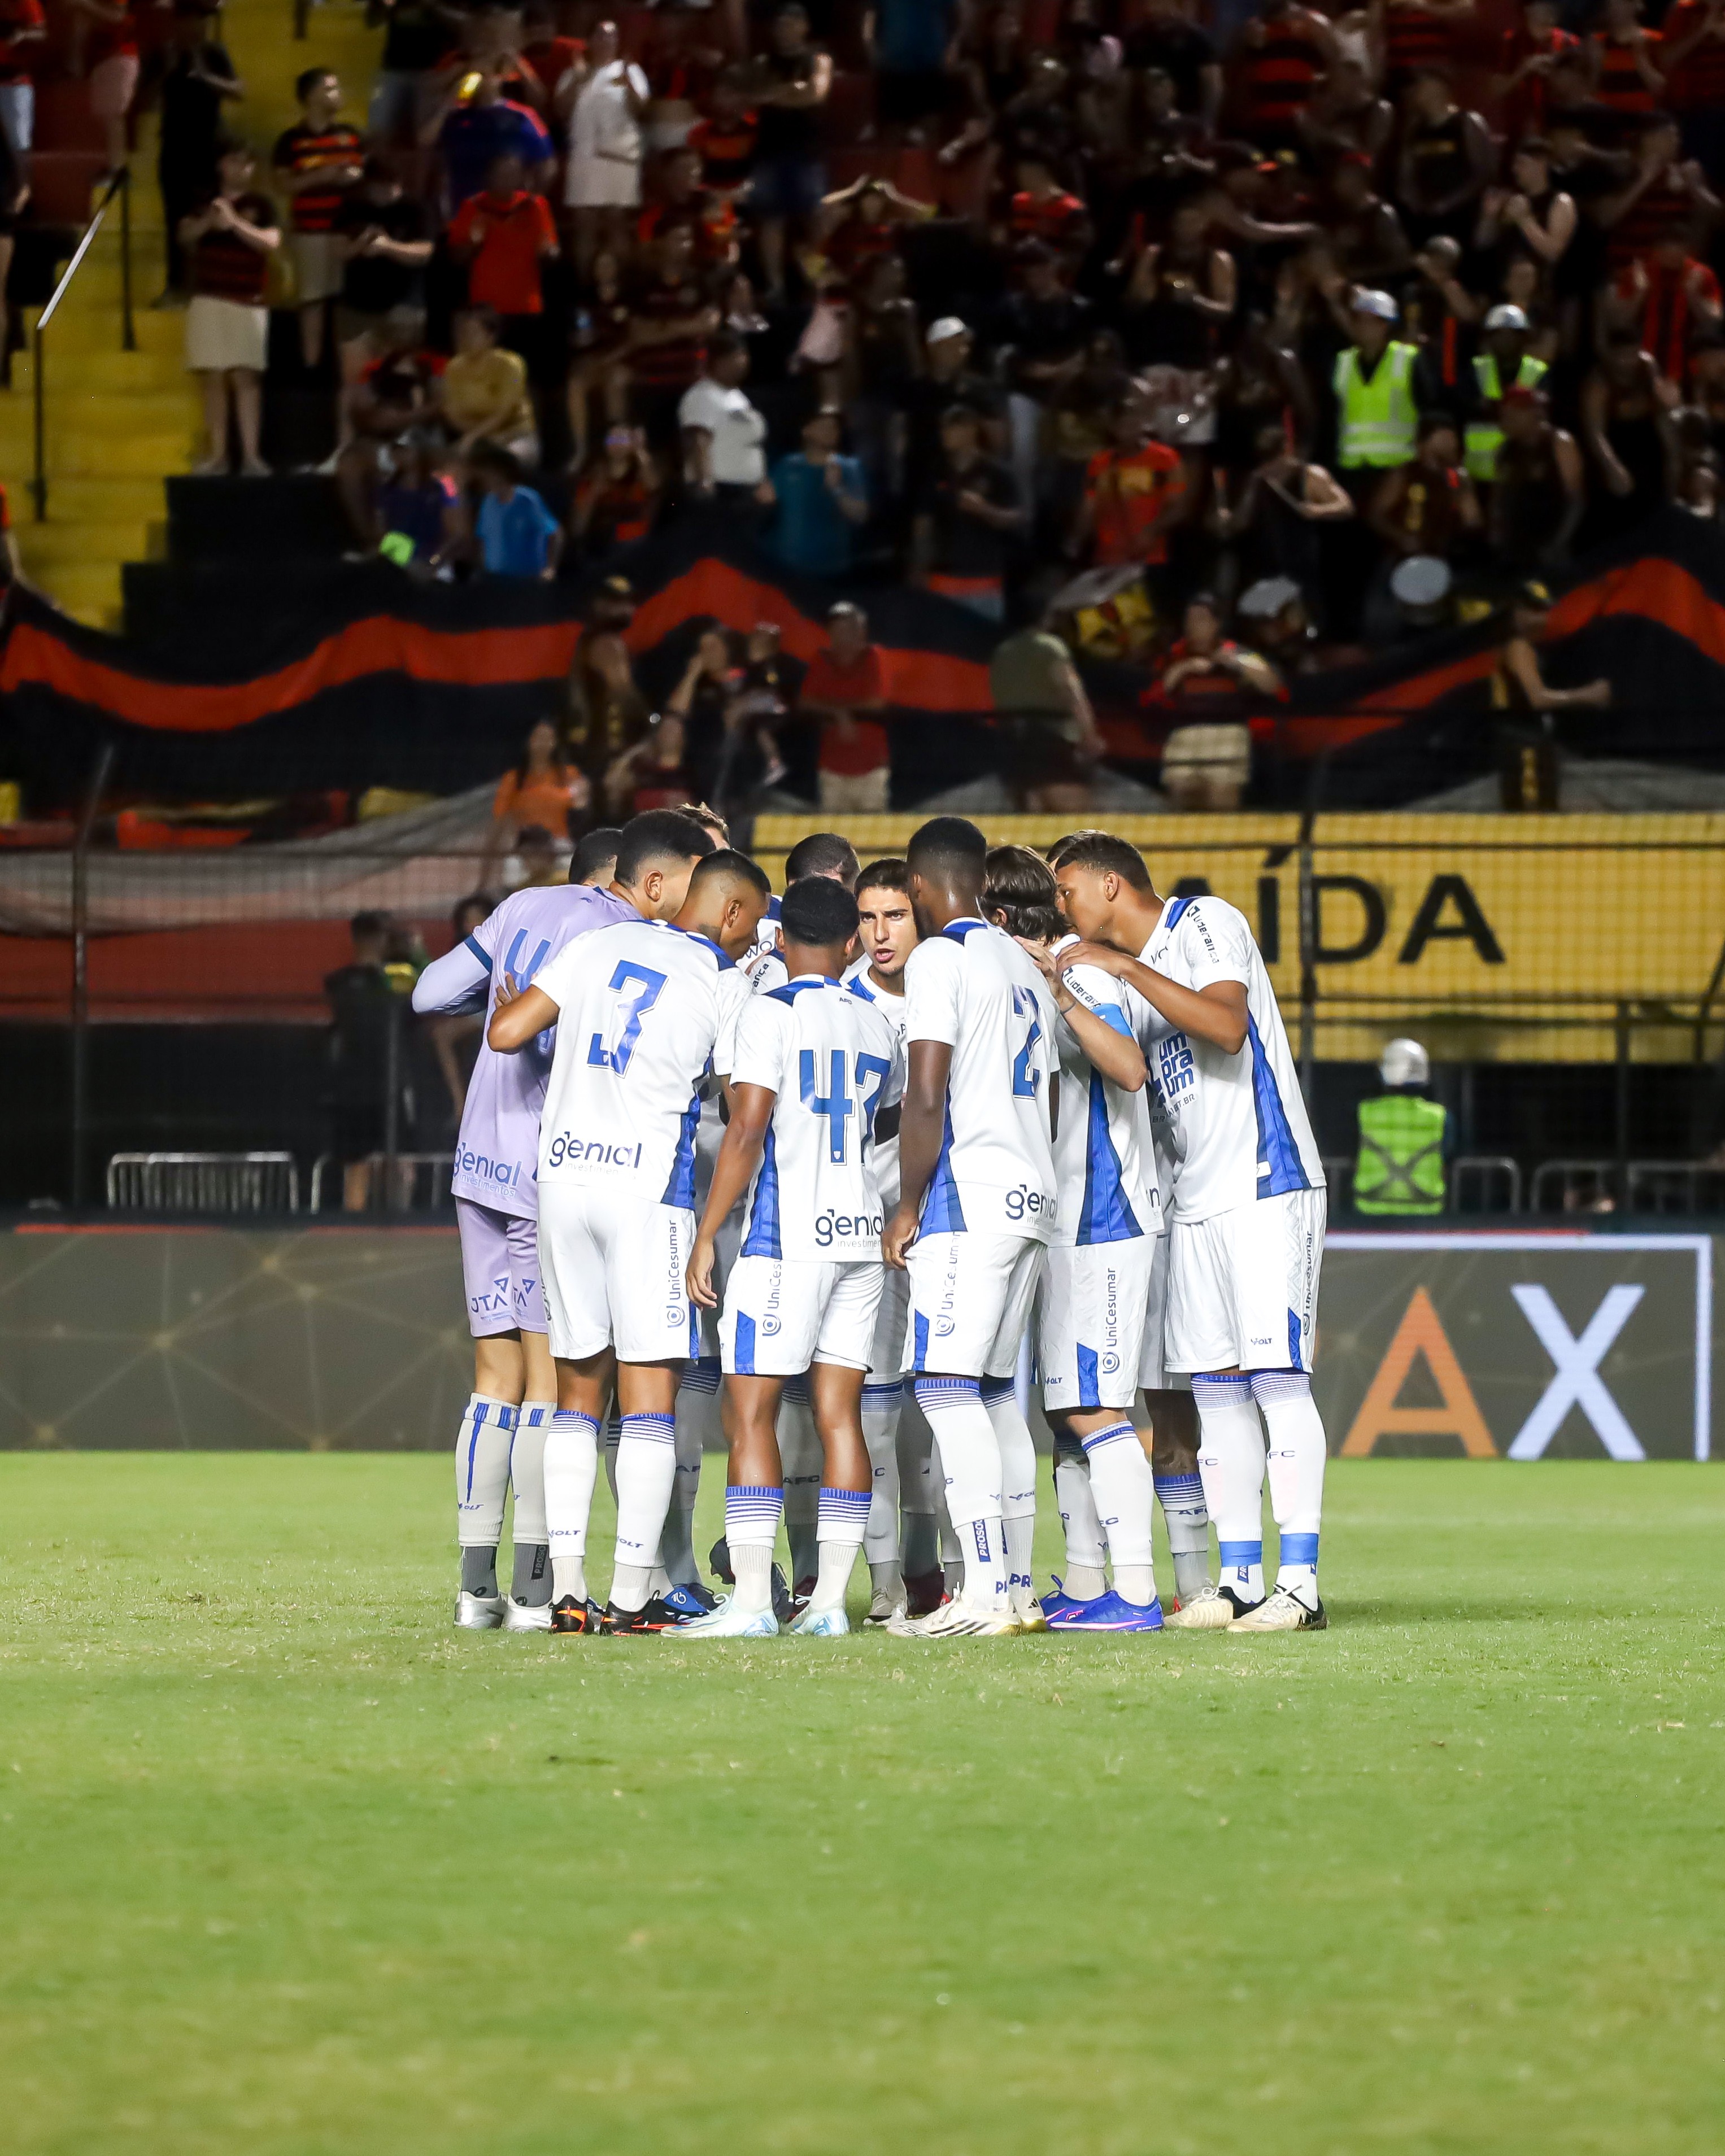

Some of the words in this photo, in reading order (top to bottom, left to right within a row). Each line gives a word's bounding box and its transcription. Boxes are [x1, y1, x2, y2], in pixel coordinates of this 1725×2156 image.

[1167, 847, 1506, 964] ÍDA
[586, 958, 670, 1079] 3
[1011, 981, 1043, 1101] 2
[799, 1049, 891, 1166] 47
[452, 1142, 522, 1186] genial
[548, 1131, 642, 1168] genial
[668, 1220, 681, 1301] UniCesumar
[1105, 1267, 1117, 1347] UniCesumar
[547, 1529, 581, 1538] VOLT
